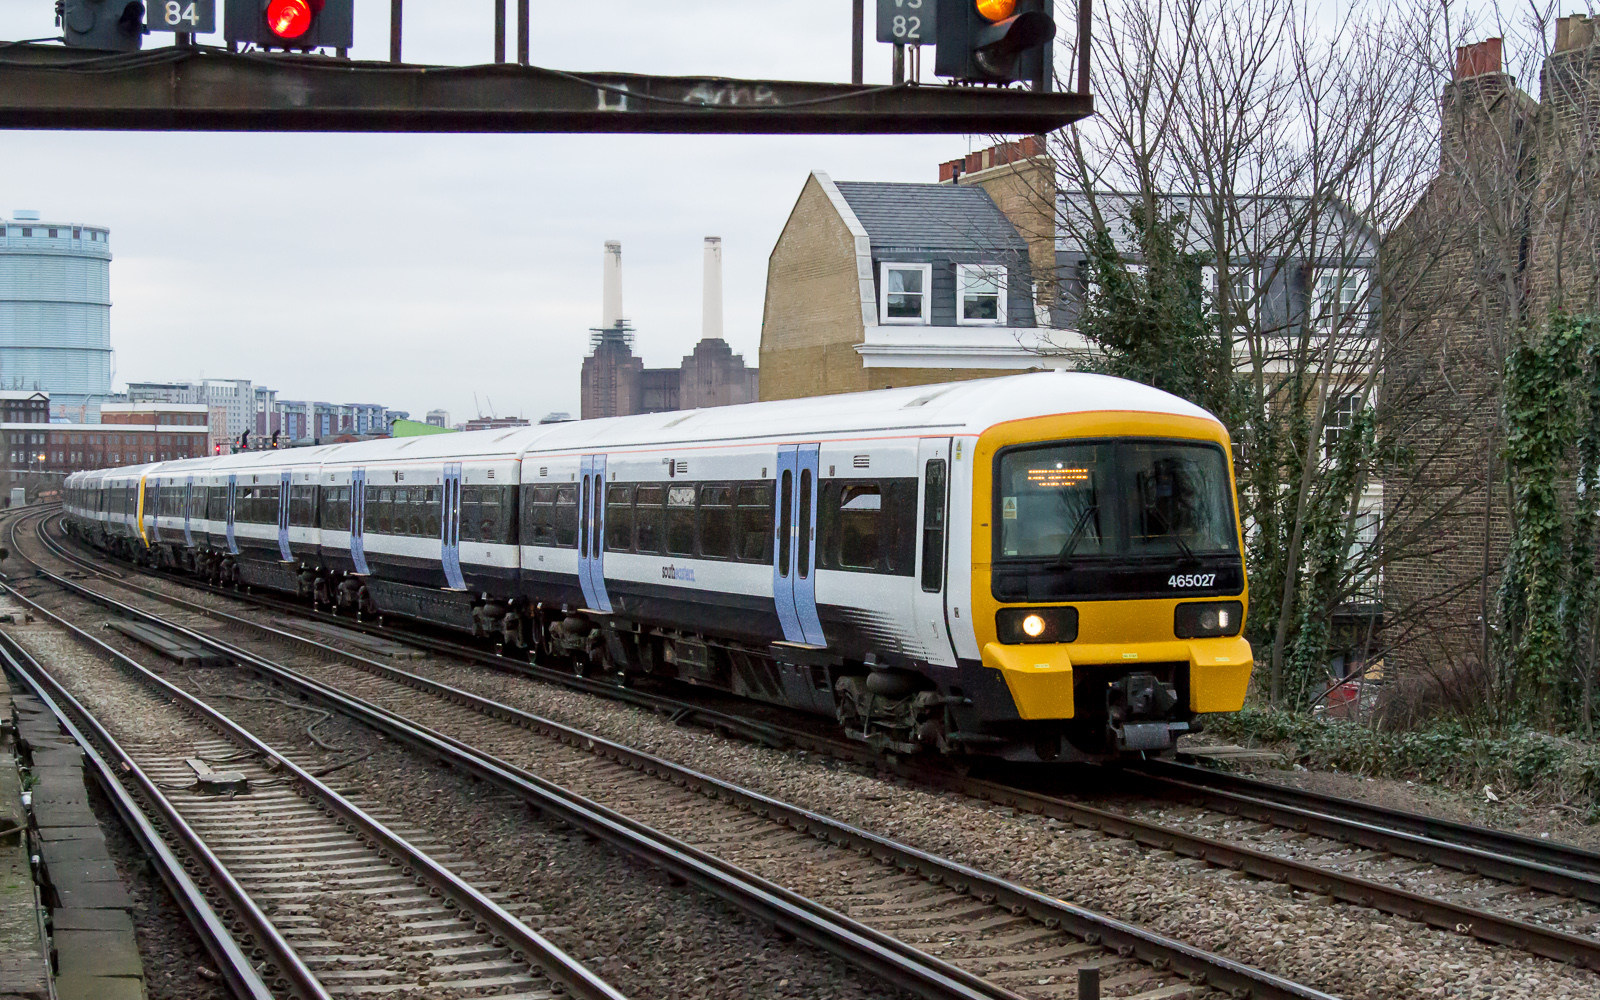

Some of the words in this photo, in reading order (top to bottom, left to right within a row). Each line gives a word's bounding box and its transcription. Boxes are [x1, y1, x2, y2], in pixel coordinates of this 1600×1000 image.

[165, 1, 199, 25] 84
[892, 15, 921, 38] 82
[1168, 573, 1216, 588] 465027
